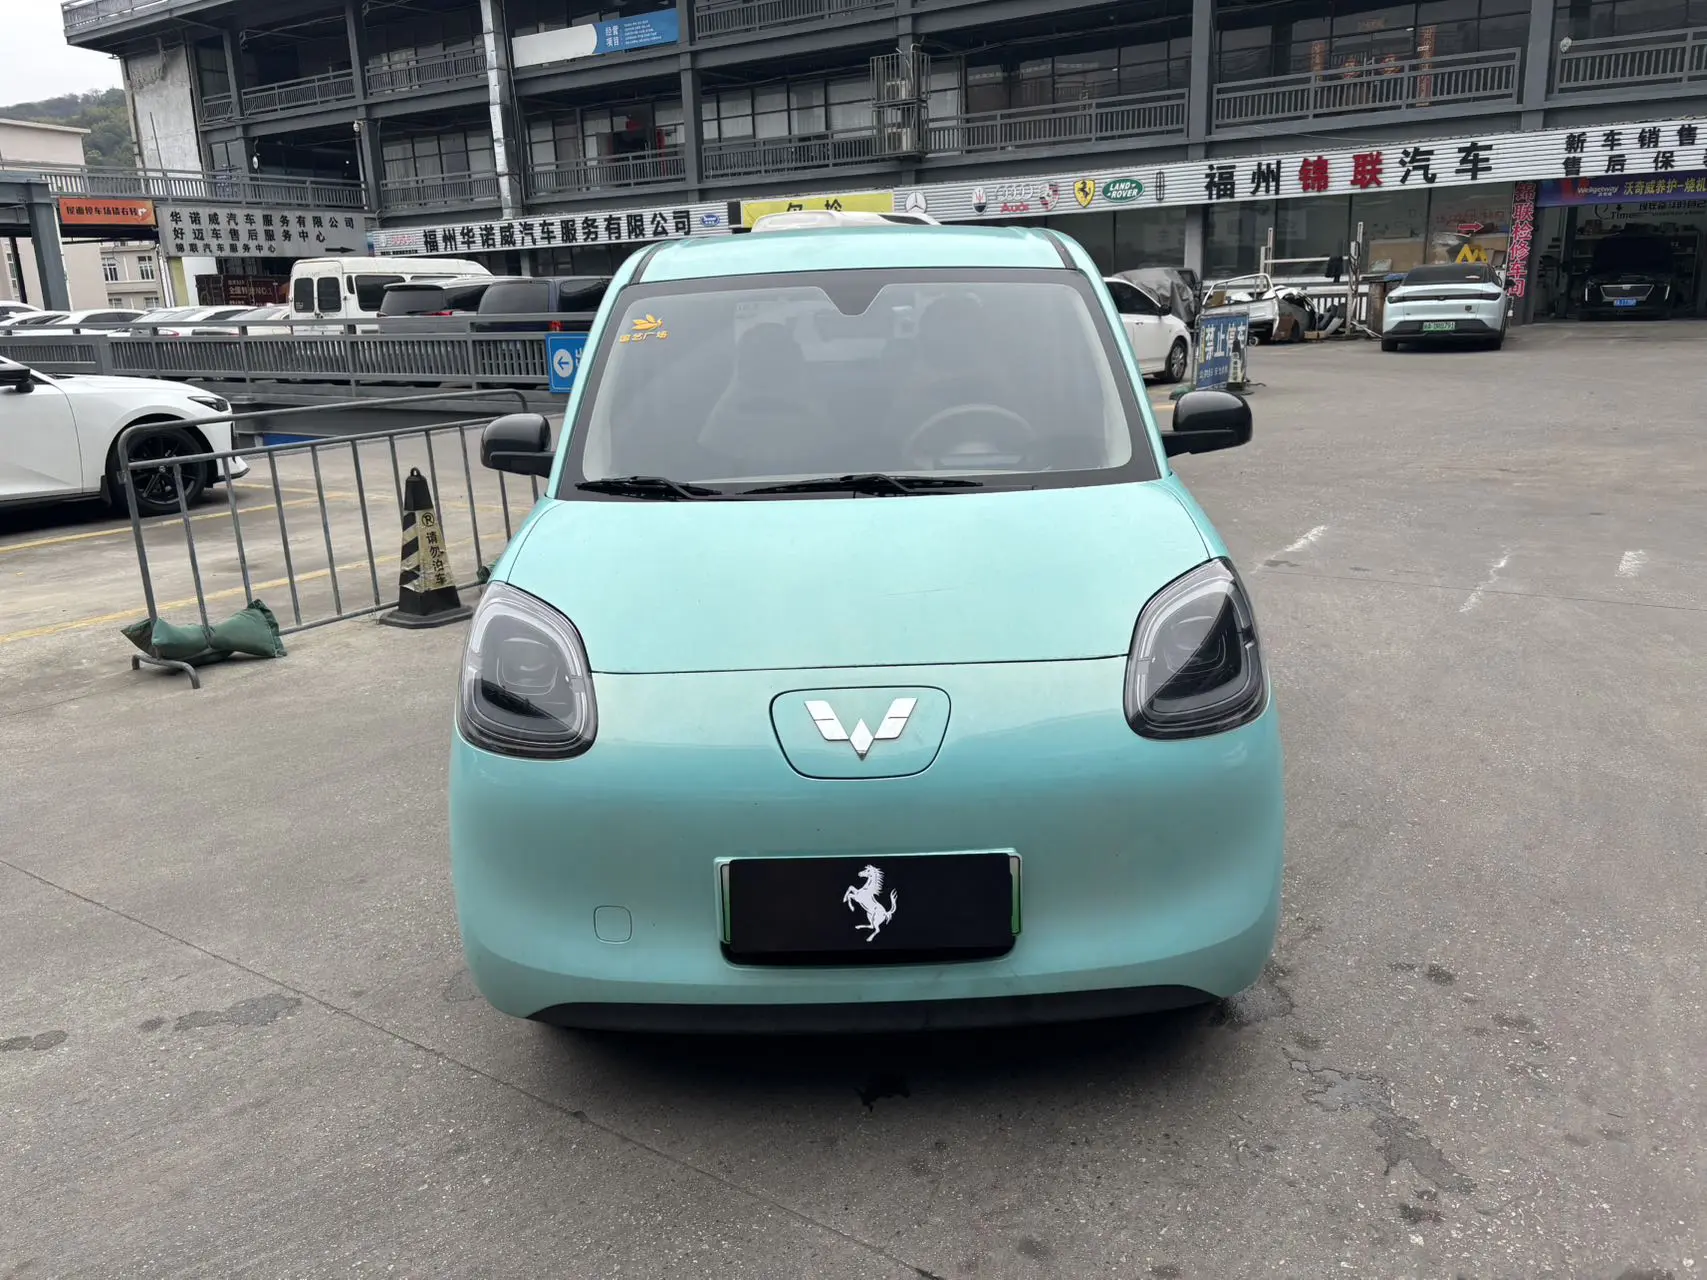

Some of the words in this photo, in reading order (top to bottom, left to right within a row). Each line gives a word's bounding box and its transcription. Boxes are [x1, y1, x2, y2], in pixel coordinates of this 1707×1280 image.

[1565, 124, 1699, 153] 新车销售
[1204, 141, 1494, 200] 福州锦联汽车
[1562, 149, 1707, 176] 售后保
[1110, 183, 1131, 192] LAND
[1111, 187, 1139, 198] ROVER
[1000, 202, 1031, 214] Audi
[170, 211, 355, 229] 华诺威汽车服务有限公司
[172, 227, 327, 243] 好迈车售后服务中心
[422, 210, 692, 254] 福州华诺威汽车服务有限公司
[175, 242, 277, 254] 锦联汽车服务中心
[426, 532, 448, 586] 请勿泊车
